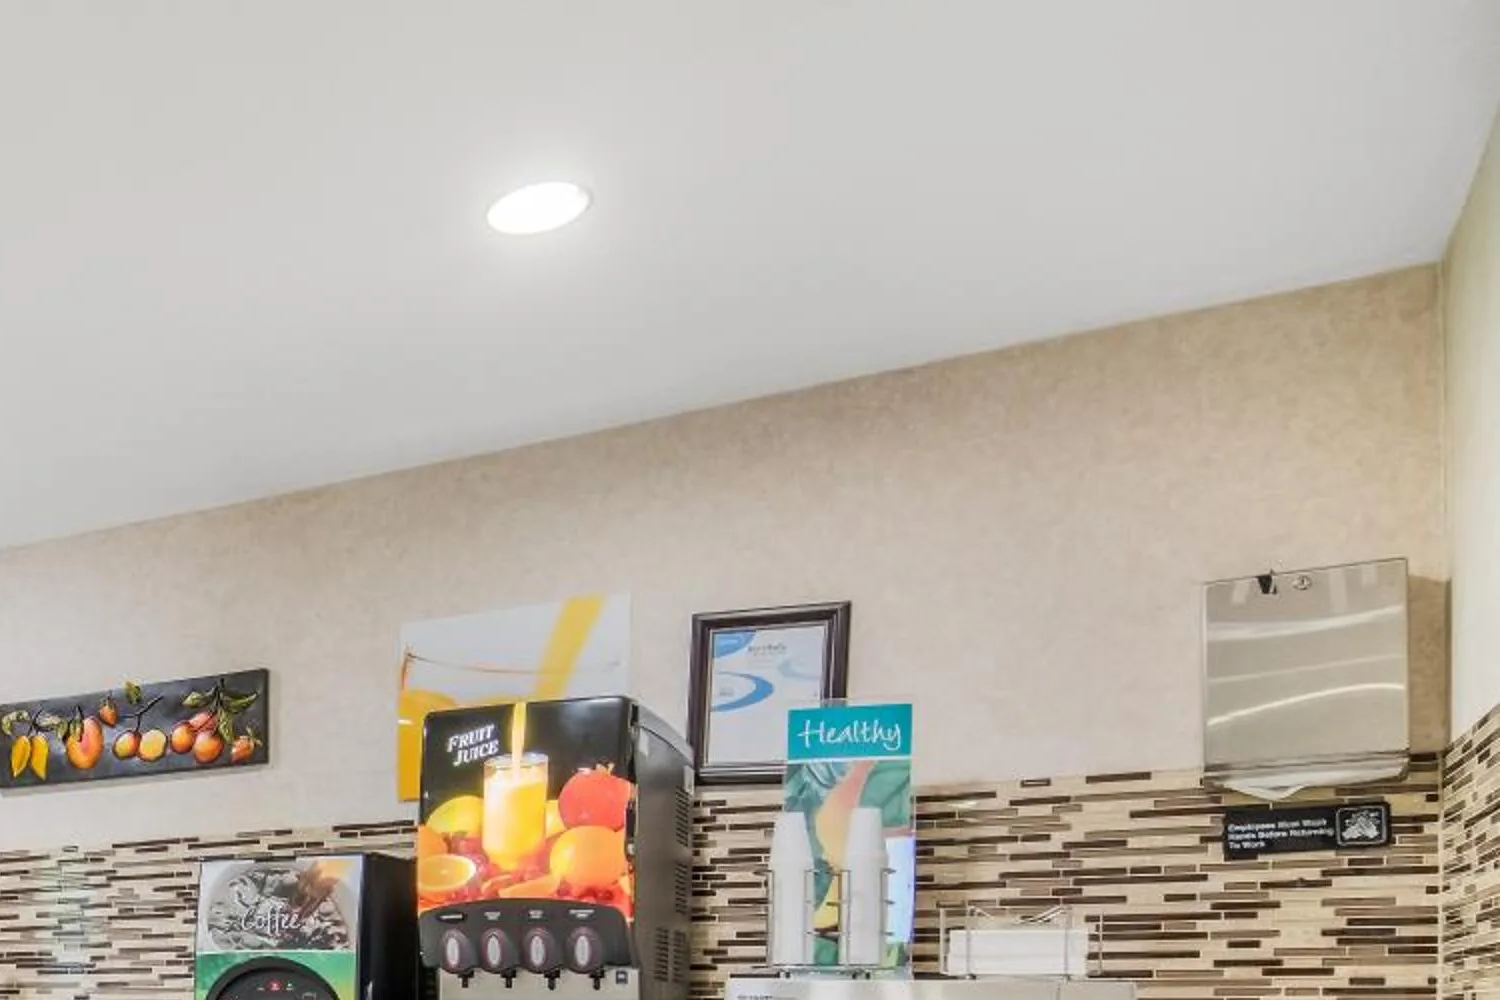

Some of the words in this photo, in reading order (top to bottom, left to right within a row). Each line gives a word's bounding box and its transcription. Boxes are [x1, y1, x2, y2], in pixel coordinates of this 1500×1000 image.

[446, 724, 496, 752] FRUIT
[796, 719, 901, 751] Healthy
[453, 740, 500, 767] JUICE
[241, 905, 301, 936] Coffee
